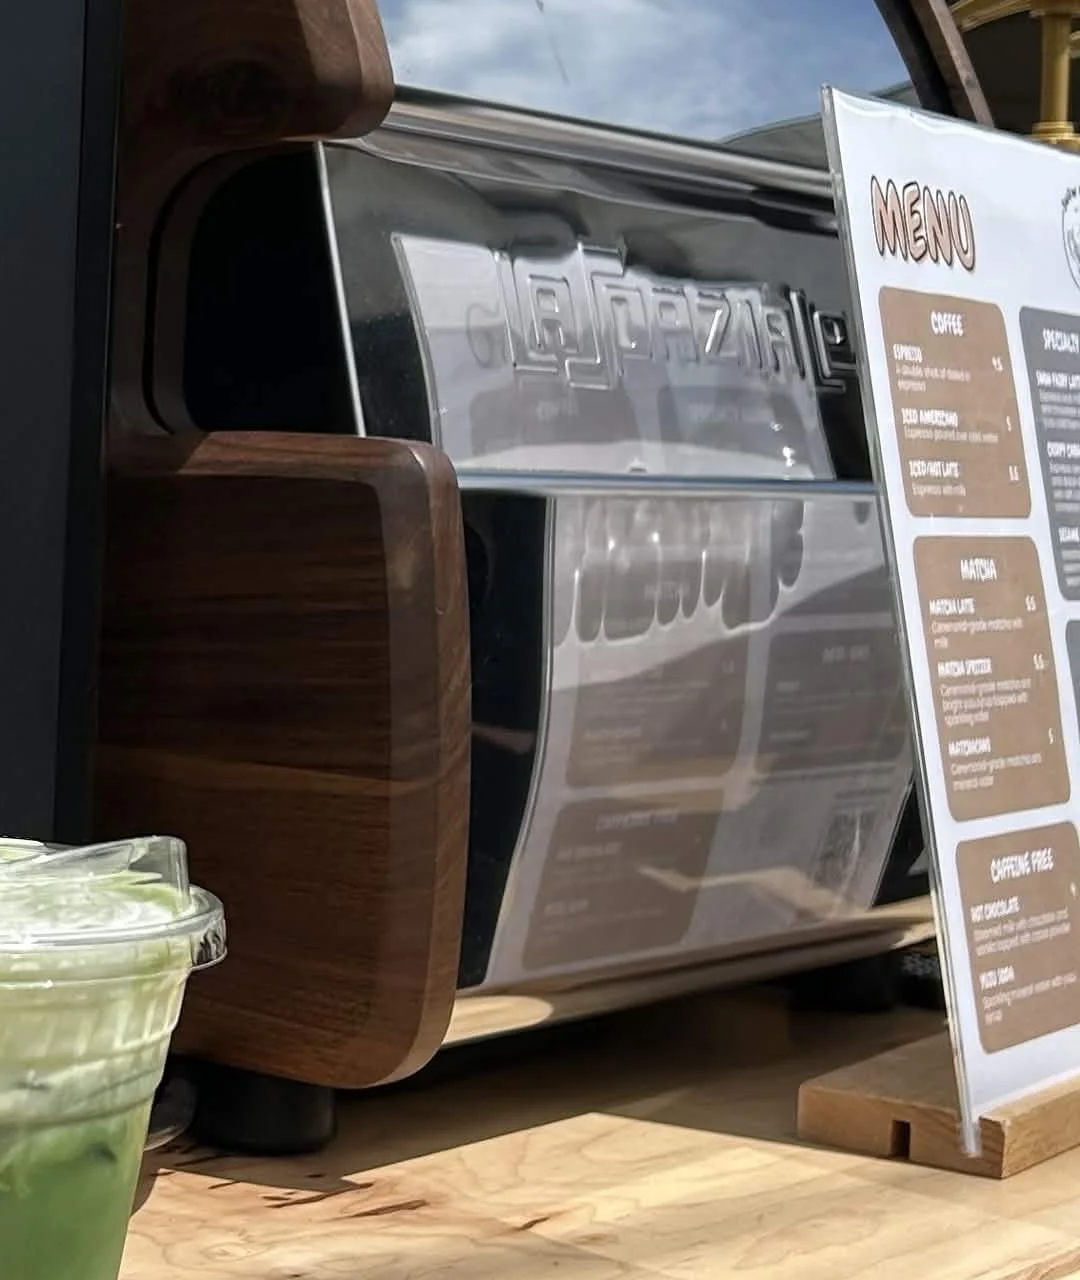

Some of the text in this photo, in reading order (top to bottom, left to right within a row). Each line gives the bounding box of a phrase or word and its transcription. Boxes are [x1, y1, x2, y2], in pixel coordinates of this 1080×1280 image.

[870, 174, 976, 272] MENU
[930, 309, 965, 337] COFFEE
[960, 558, 998, 582] MATCHA
[929, 599, 957, 616] MATCHA
[990, 847, 1054, 884] CAFFEINE FREE
[984, 895, 1020, 921] CHOCOLATE
